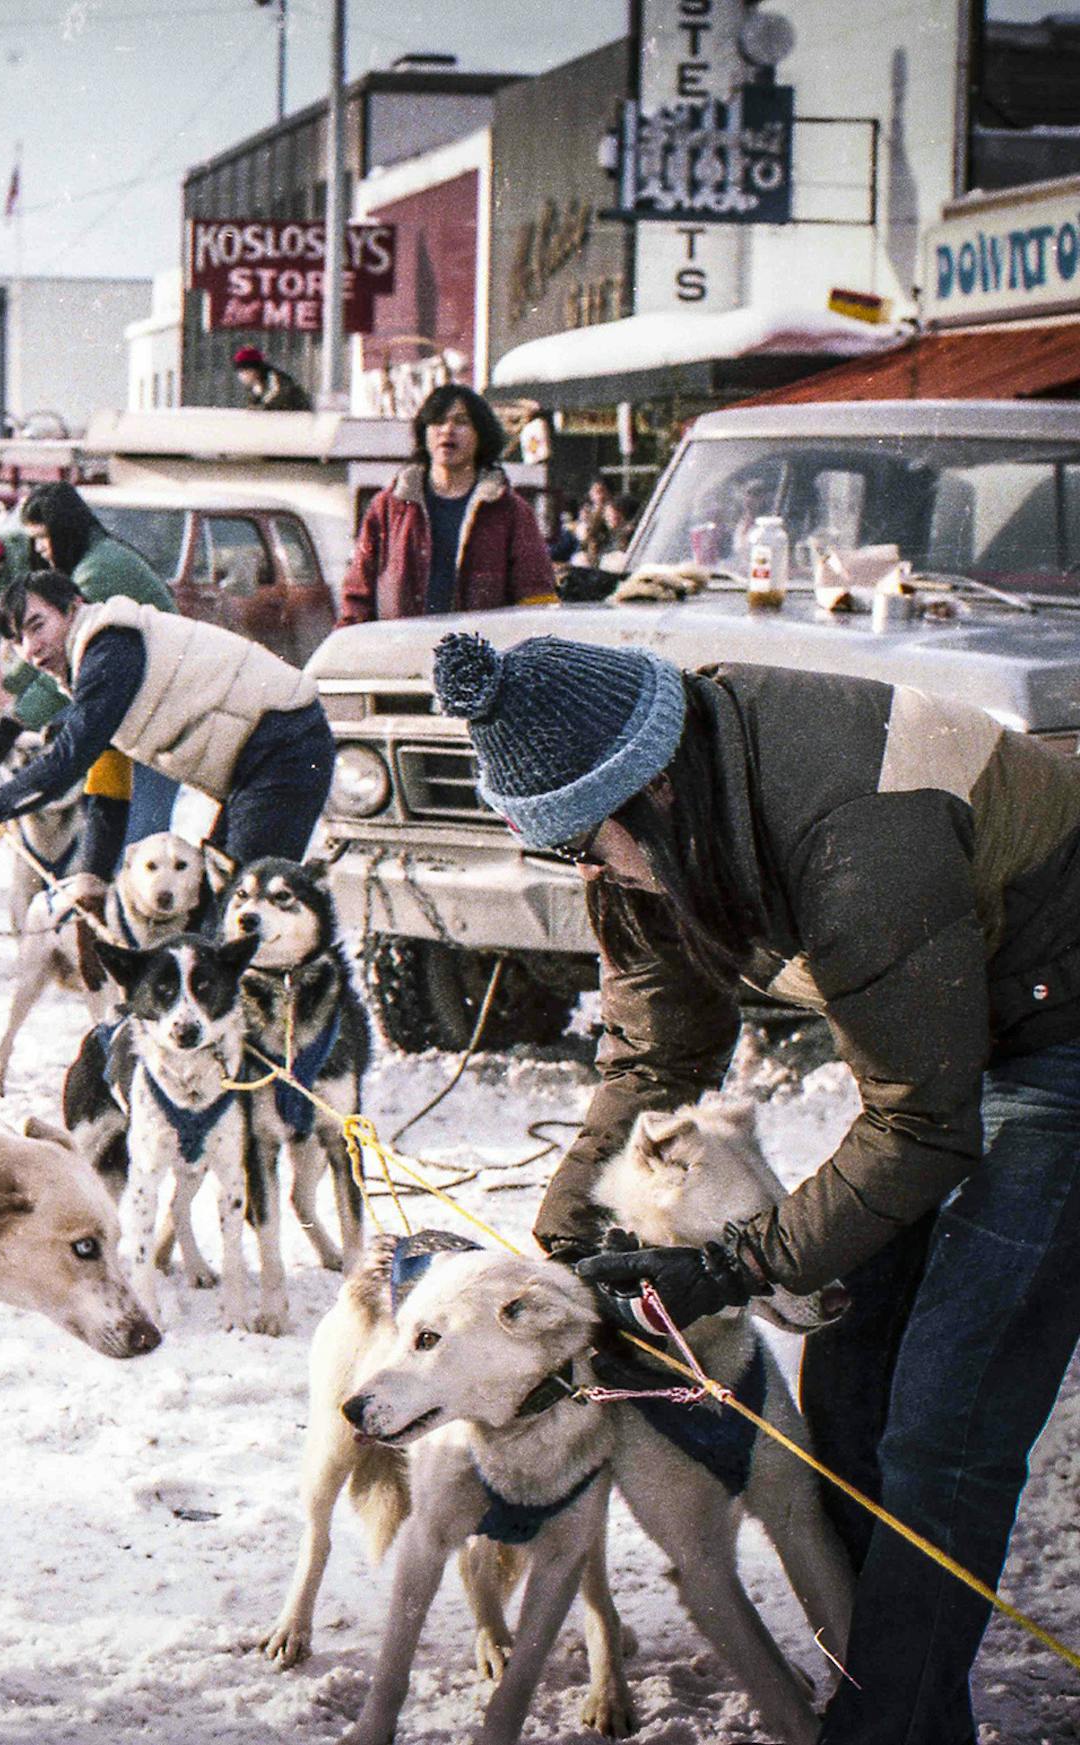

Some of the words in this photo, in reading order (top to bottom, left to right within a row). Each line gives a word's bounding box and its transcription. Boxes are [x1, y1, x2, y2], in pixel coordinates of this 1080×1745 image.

[195, 223, 391, 275] KOSLOSYS
[935, 214, 1080, 298] DOWNTO
[228, 266, 356, 299] STORE
[262, 300, 321, 329] ME
